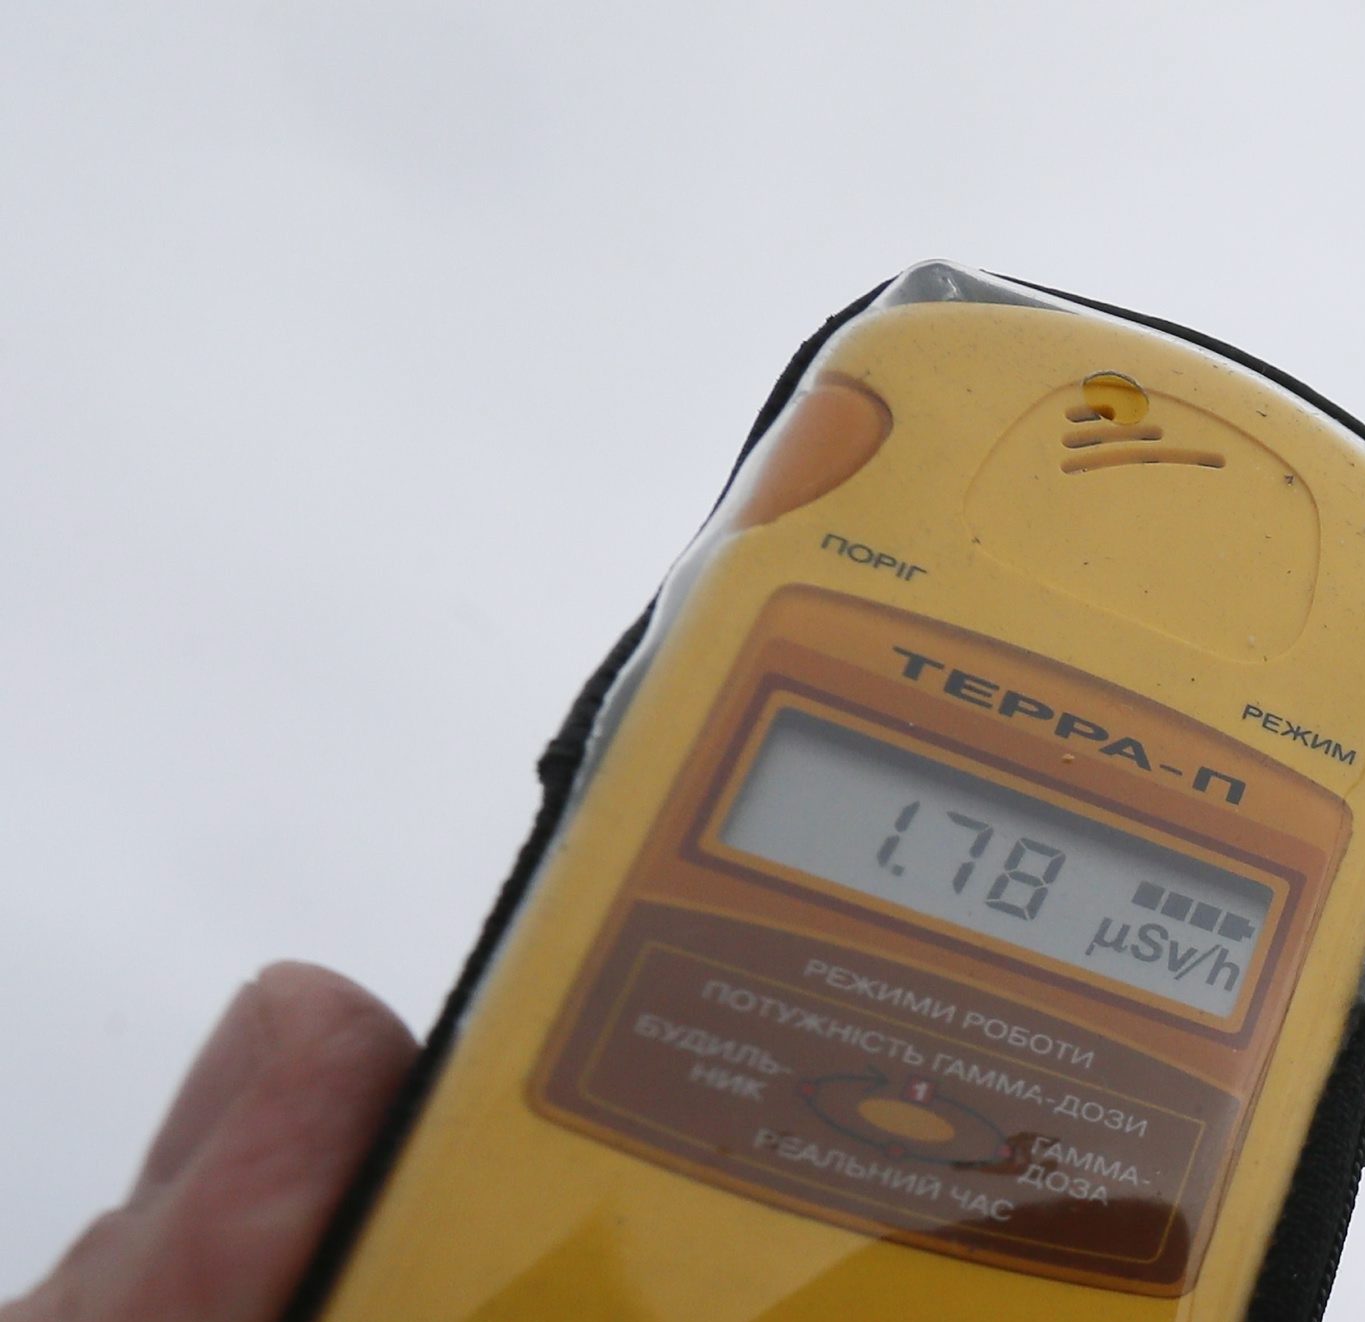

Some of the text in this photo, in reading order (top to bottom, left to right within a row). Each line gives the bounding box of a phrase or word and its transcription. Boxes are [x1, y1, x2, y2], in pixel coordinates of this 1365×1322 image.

[820, 532, 928, 583] ПОРІГ
[892, 645, 1247, 807] ТЕРРА-П
[1242, 703, 1357, 767] РЕЖИМ
[877, 800, 1067, 921] 1.78
[803, 959, 1095, 1071] РЕЖИМИ РОБОТИ
[689, 1061, 768, 1103] НИК
[701, 979, 1148, 1139] ПОТУЖНІСТЬ ГАММА-ДОЗИ
[911, 1080, 929, 1101] 1
[752, 1126, 1017, 1223] РЕАЛЬНИЙ ЧАС
[1016, 1162, 1110, 1207] ДОЗА
[1029, 1135, 1151, 1188] ГАММА-
